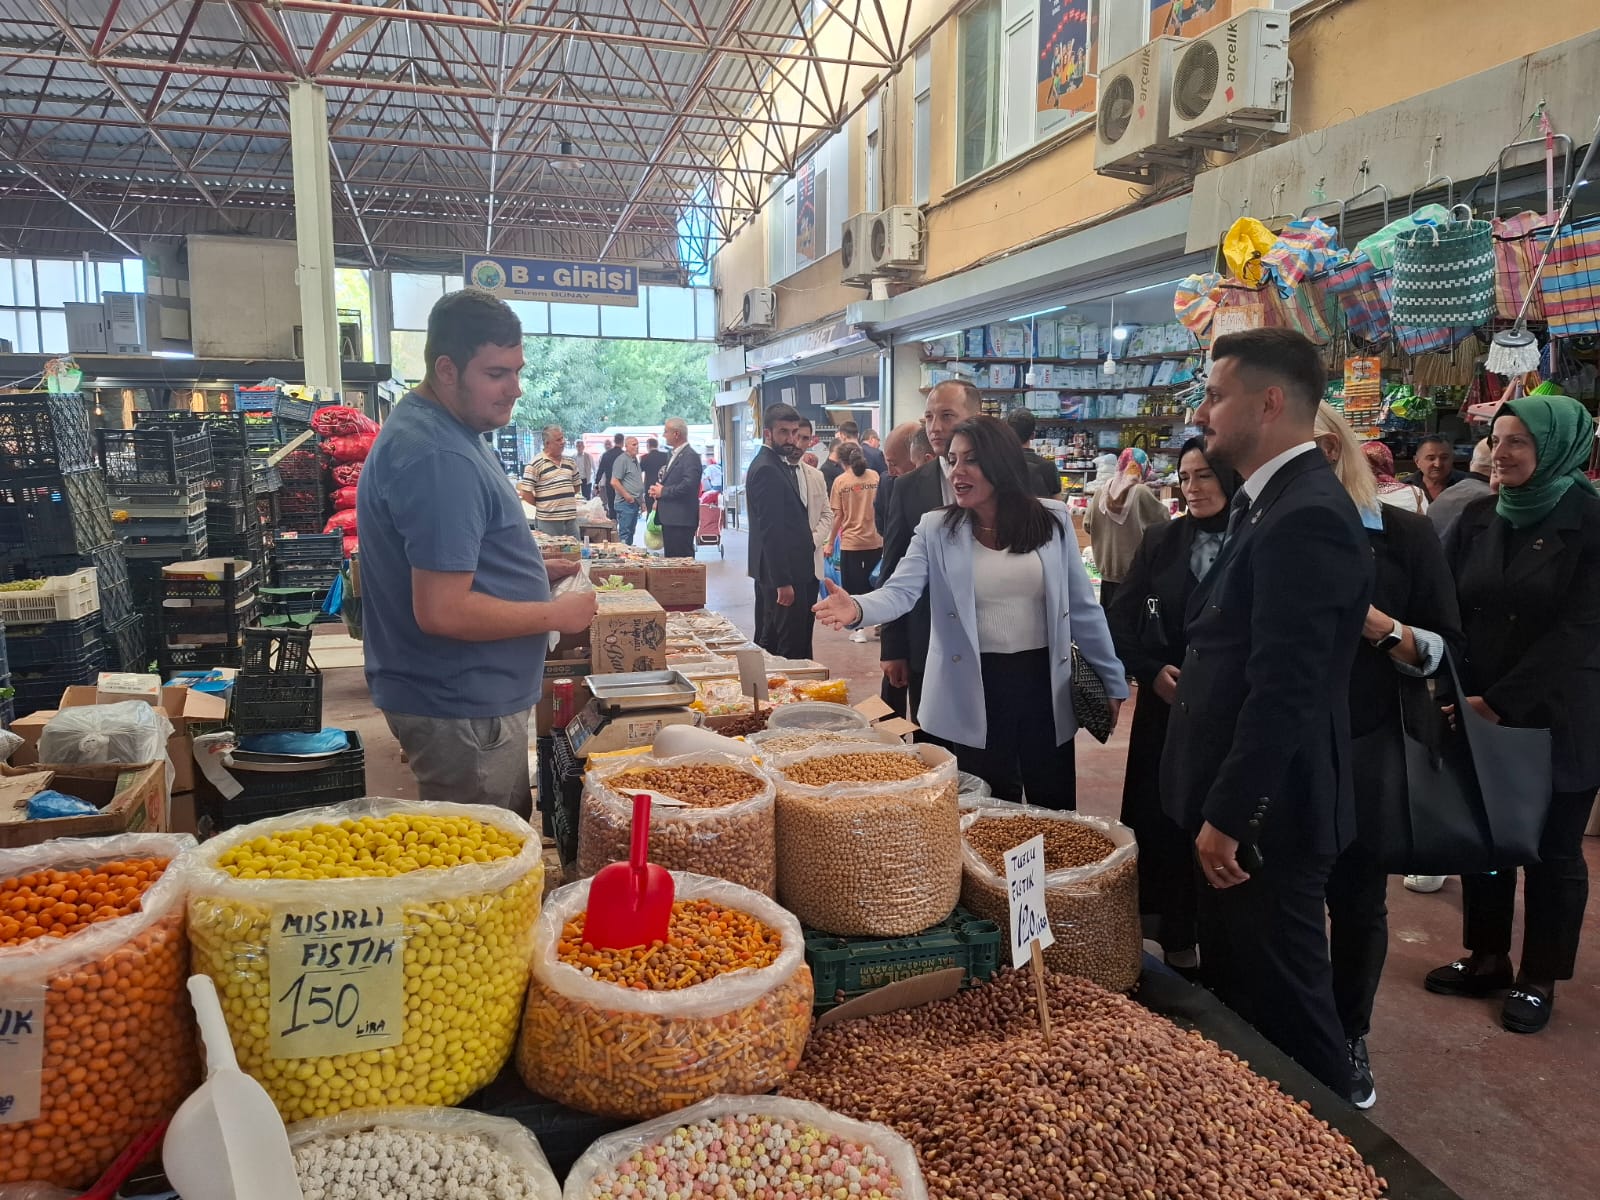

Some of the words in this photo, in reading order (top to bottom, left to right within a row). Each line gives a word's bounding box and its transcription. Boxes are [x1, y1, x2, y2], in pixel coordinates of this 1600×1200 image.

[1227, 23, 1238, 82] arçelik
[1140, 47, 1151, 101] arçelik
[511, 265, 529, 283] B
[553, 265, 632, 293] GİRİŞİ
[513, 289, 548, 297] Ekrem
[1011, 847, 1036, 872] TUZLU
[1011, 868, 1035, 902] FISTIK
[281, 906, 384, 934] MISIRLI
[1018, 903, 1035, 948] 120
[301, 937, 395, 968] FISTIK
[278, 973, 360, 1037] 150
